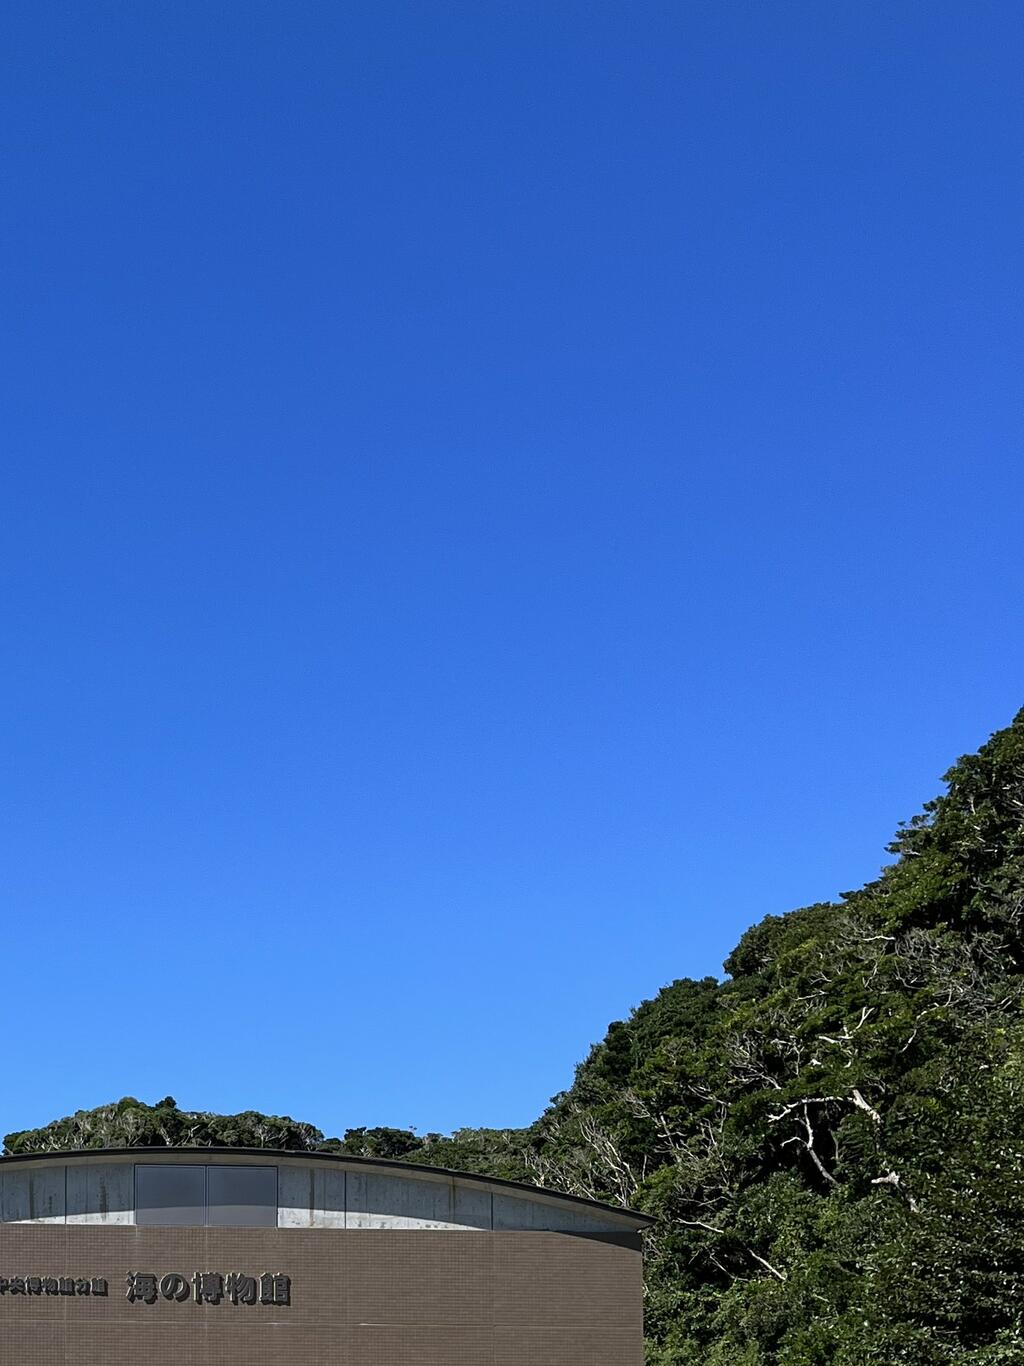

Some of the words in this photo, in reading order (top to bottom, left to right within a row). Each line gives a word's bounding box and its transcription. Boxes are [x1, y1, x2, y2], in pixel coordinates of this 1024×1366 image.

[126, 1271, 291, 1305] 海の博物館
